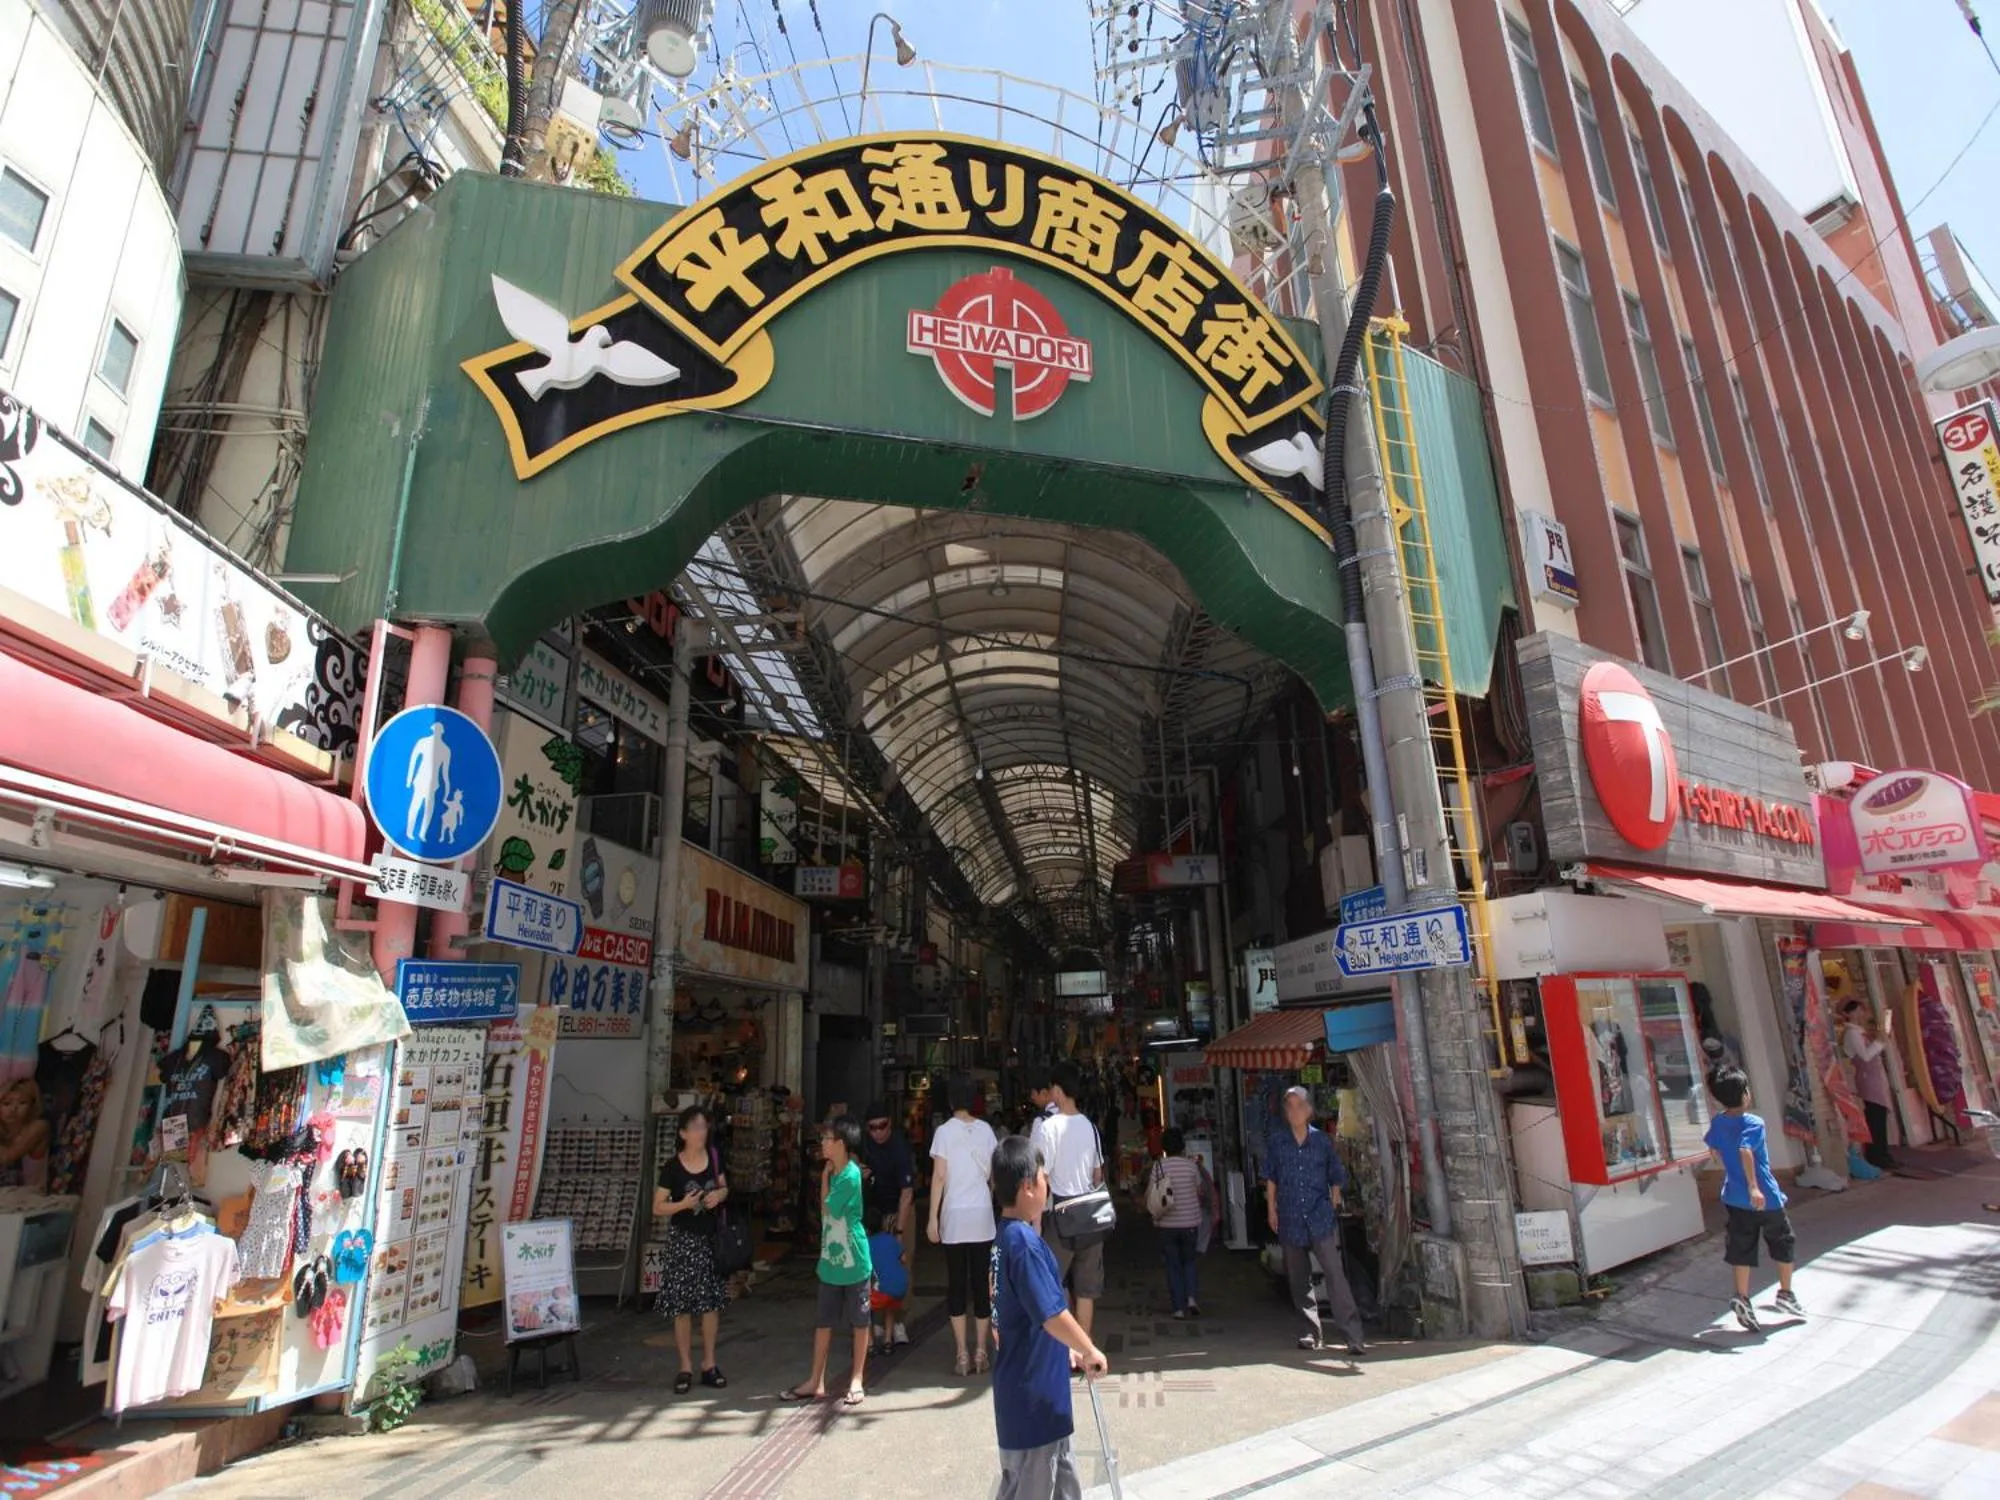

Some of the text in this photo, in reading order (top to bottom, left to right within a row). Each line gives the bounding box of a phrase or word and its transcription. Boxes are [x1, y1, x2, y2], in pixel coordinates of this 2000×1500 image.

[657, 142, 1294, 405] 平和通り商店街
[917, 315, 1084, 368] HEIWADORI
[1944, 418, 1984, 450] 3F
[1960, 461, 2000, 582] 名護そ
[579, 658, 658, 732] 木かげカフェ
[507, 773, 574, 834] 木かげ
[1677, 779, 1815, 848] T-SHIRT-YA.COM
[1862, 822, 1967, 856] ポルシェ
[506, 891, 567, 930] 平和通り
[628, 916, 652, 932] SEIKO
[517, 923, 554, 943] Heiwadori
[603, 934, 649, 964] CASIO
[1358, 917, 1444, 949] 平和通り
[1378, 947, 1429, 966] Heiwadori
[406, 1047, 471, 1063] 木かげカフェ
